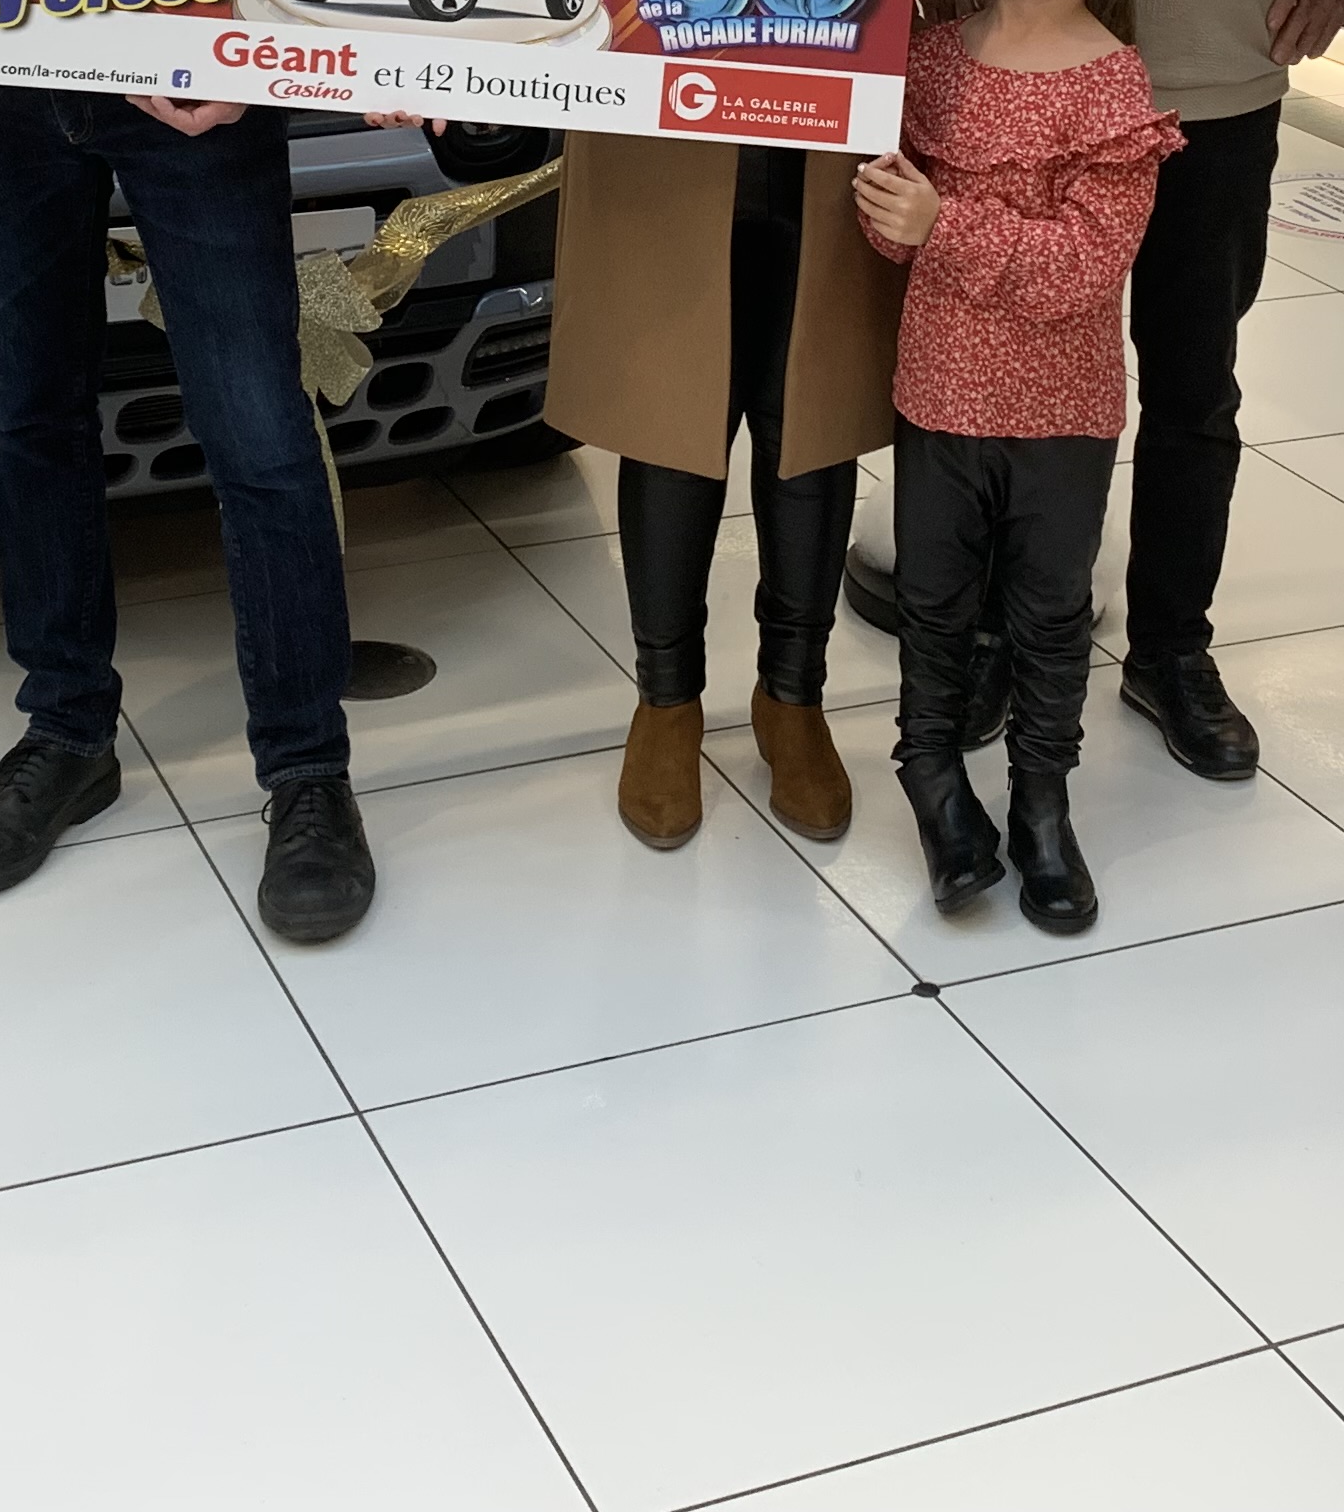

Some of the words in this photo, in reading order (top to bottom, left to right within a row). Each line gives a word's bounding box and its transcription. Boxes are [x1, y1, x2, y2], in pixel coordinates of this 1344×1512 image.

[638, 0, 662, 19] de
[660, 17, 757, 53] ROCADE
[761, 16, 859, 51] FURIANI
[213, 31, 358, 76] Géant
[268, 78, 353, 102] Casino
[373, 65, 404, 90] et
[415, 64, 454, 93] 42
[466, 67, 627, 112] boutiques
[722, 96, 745, 108] LA
[750, 99, 817, 115] GALERIE
[722, 111, 736, 120] LA
[739, 113, 788, 125] ROCADE
[791, 117, 839, 129] FURIANI
